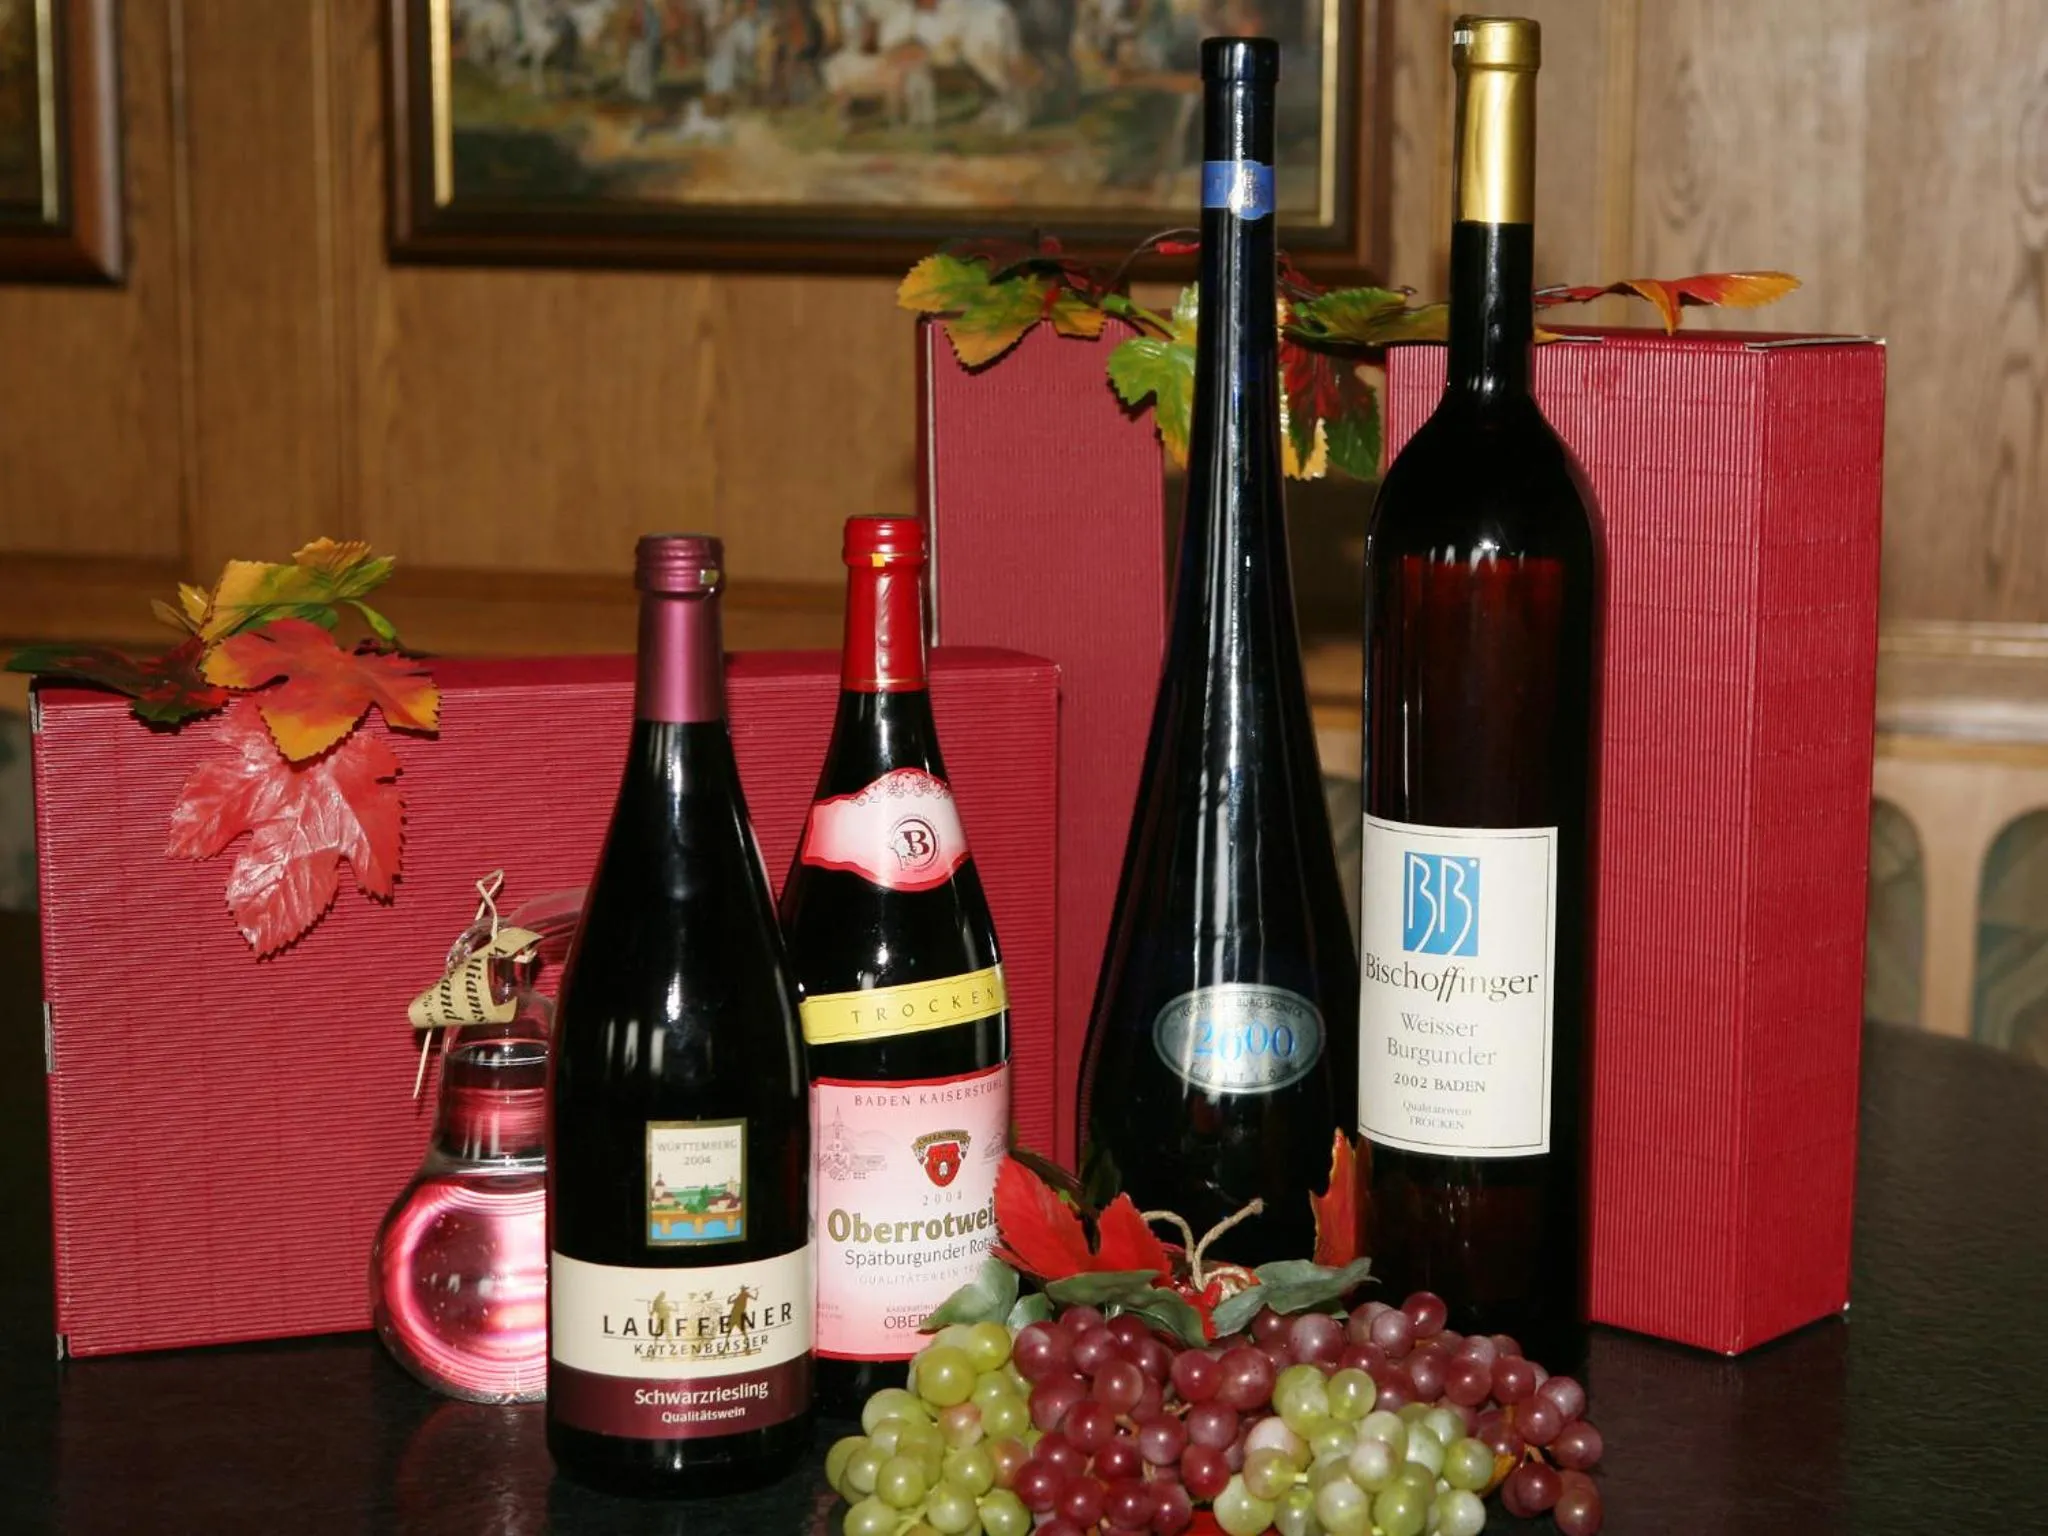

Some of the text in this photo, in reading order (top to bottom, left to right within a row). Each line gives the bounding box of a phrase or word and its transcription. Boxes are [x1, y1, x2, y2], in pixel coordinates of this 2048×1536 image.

[899, 829, 931, 857] B
[1365, 952, 1540, 1003] Bischoffinger
[852, 987, 994, 1024] TROCKEN
[1400, 1012, 1479, 1037] Weisser
[1192, 1019, 1296, 1061] 2000
[1386, 1036, 1498, 1067] Burgunder
[1393, 1072, 1487, 1093] 2002 BADEN
[854, 1094, 911, 1107] BADEN
[1408, 1115, 1465, 1130] TROCKEN
[683, 1155, 712, 1167] 2004
[827, 1196, 995, 1244] Oberrotwei
[844, 1245, 966, 1269] Spätburgunder
[602, 1301, 793, 1337] LAUFFENER
[633, 1334, 769, 1356] KATZENBEISSER
[633, 1381, 769, 1406] Schwarzriesling
[661, 1405, 746, 1424] Qualitätswein
